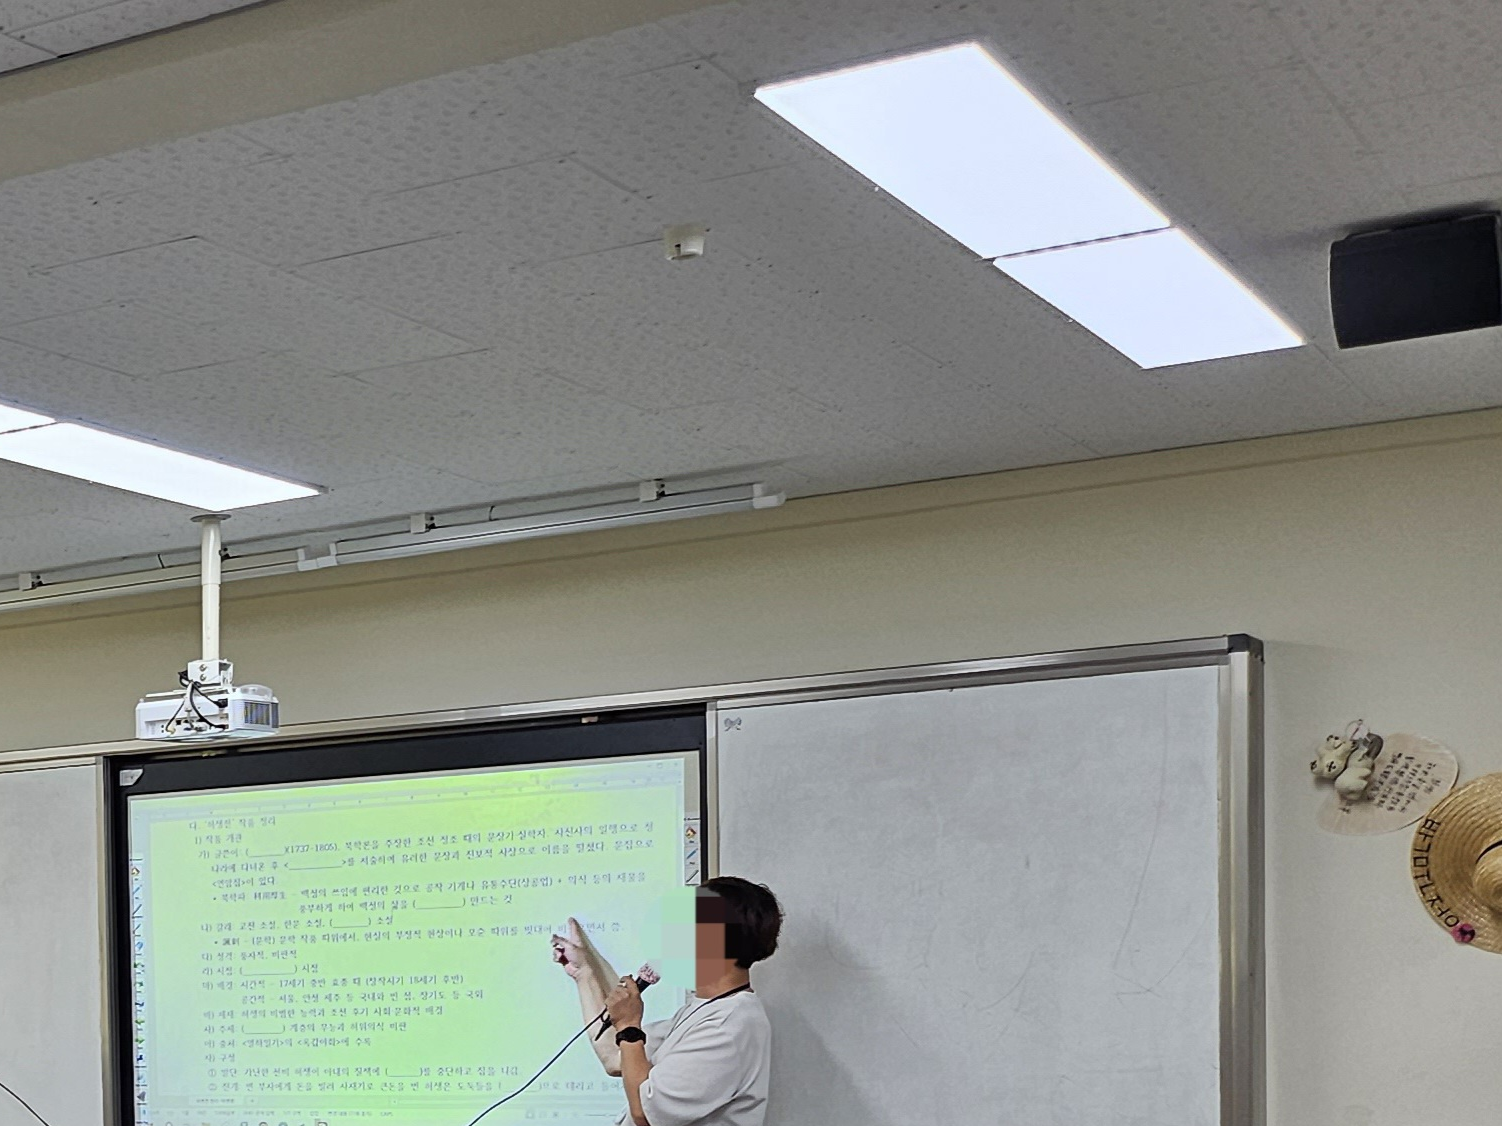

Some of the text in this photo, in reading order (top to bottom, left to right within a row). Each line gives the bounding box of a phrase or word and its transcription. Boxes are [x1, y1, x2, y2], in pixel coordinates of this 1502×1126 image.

[386, 838, 411, 848] 주장한
[418, 836, 434, 846] 조선
[440, 835, 457, 845] 정조
[463, 833, 480, 843] 때의
[211, 862, 236, 873] 나라에
[241, 861, 265, 872] 다녀온
[361, 854, 395, 865] 저술하여
[401, 852, 427, 863] 유려한
[434, 850, 460, 861] 문장과
[466, 848, 493, 860] 진보적
[499, 846, 536, 857] 사상으로
[542, 844, 569, 855] 이름을
[615, 839, 654, 851] 문집으로
[301, 888, 326, 898] 백성의
[332, 887, 357, 897] 쓰임에
[363, 886, 388, 896] 편리한
[394, 884, 421, 895] 것으로
[448, 880, 475, 891] 기계나
[299, 903, 333, 913] 풍부하게
[338, 901, 354, 912] 하여
[359, 900, 385, 911] 백성의
[470, 895, 497, 906] 만드는
[504, 894, 512, 904] 것
[377, 915, 393, 925] 소설
[279, 935, 295, 945] 문학
[364, 931, 390, 942] 현실의
[428, 928, 462, 939] 현상이나
[271, 949, 297, 960] 비판적
[241, 979, 265, 989] 시간적
[279, 978, 305, 988] 17세기
[331, 1007, 347, 1017] 조선
[353, 1006, 369, 1016] 후기
[390, 1021, 406, 1032] 비판
[245, 1067, 269, 1077] 가난한
[437, 1067, 472, 1077] 중단하고
